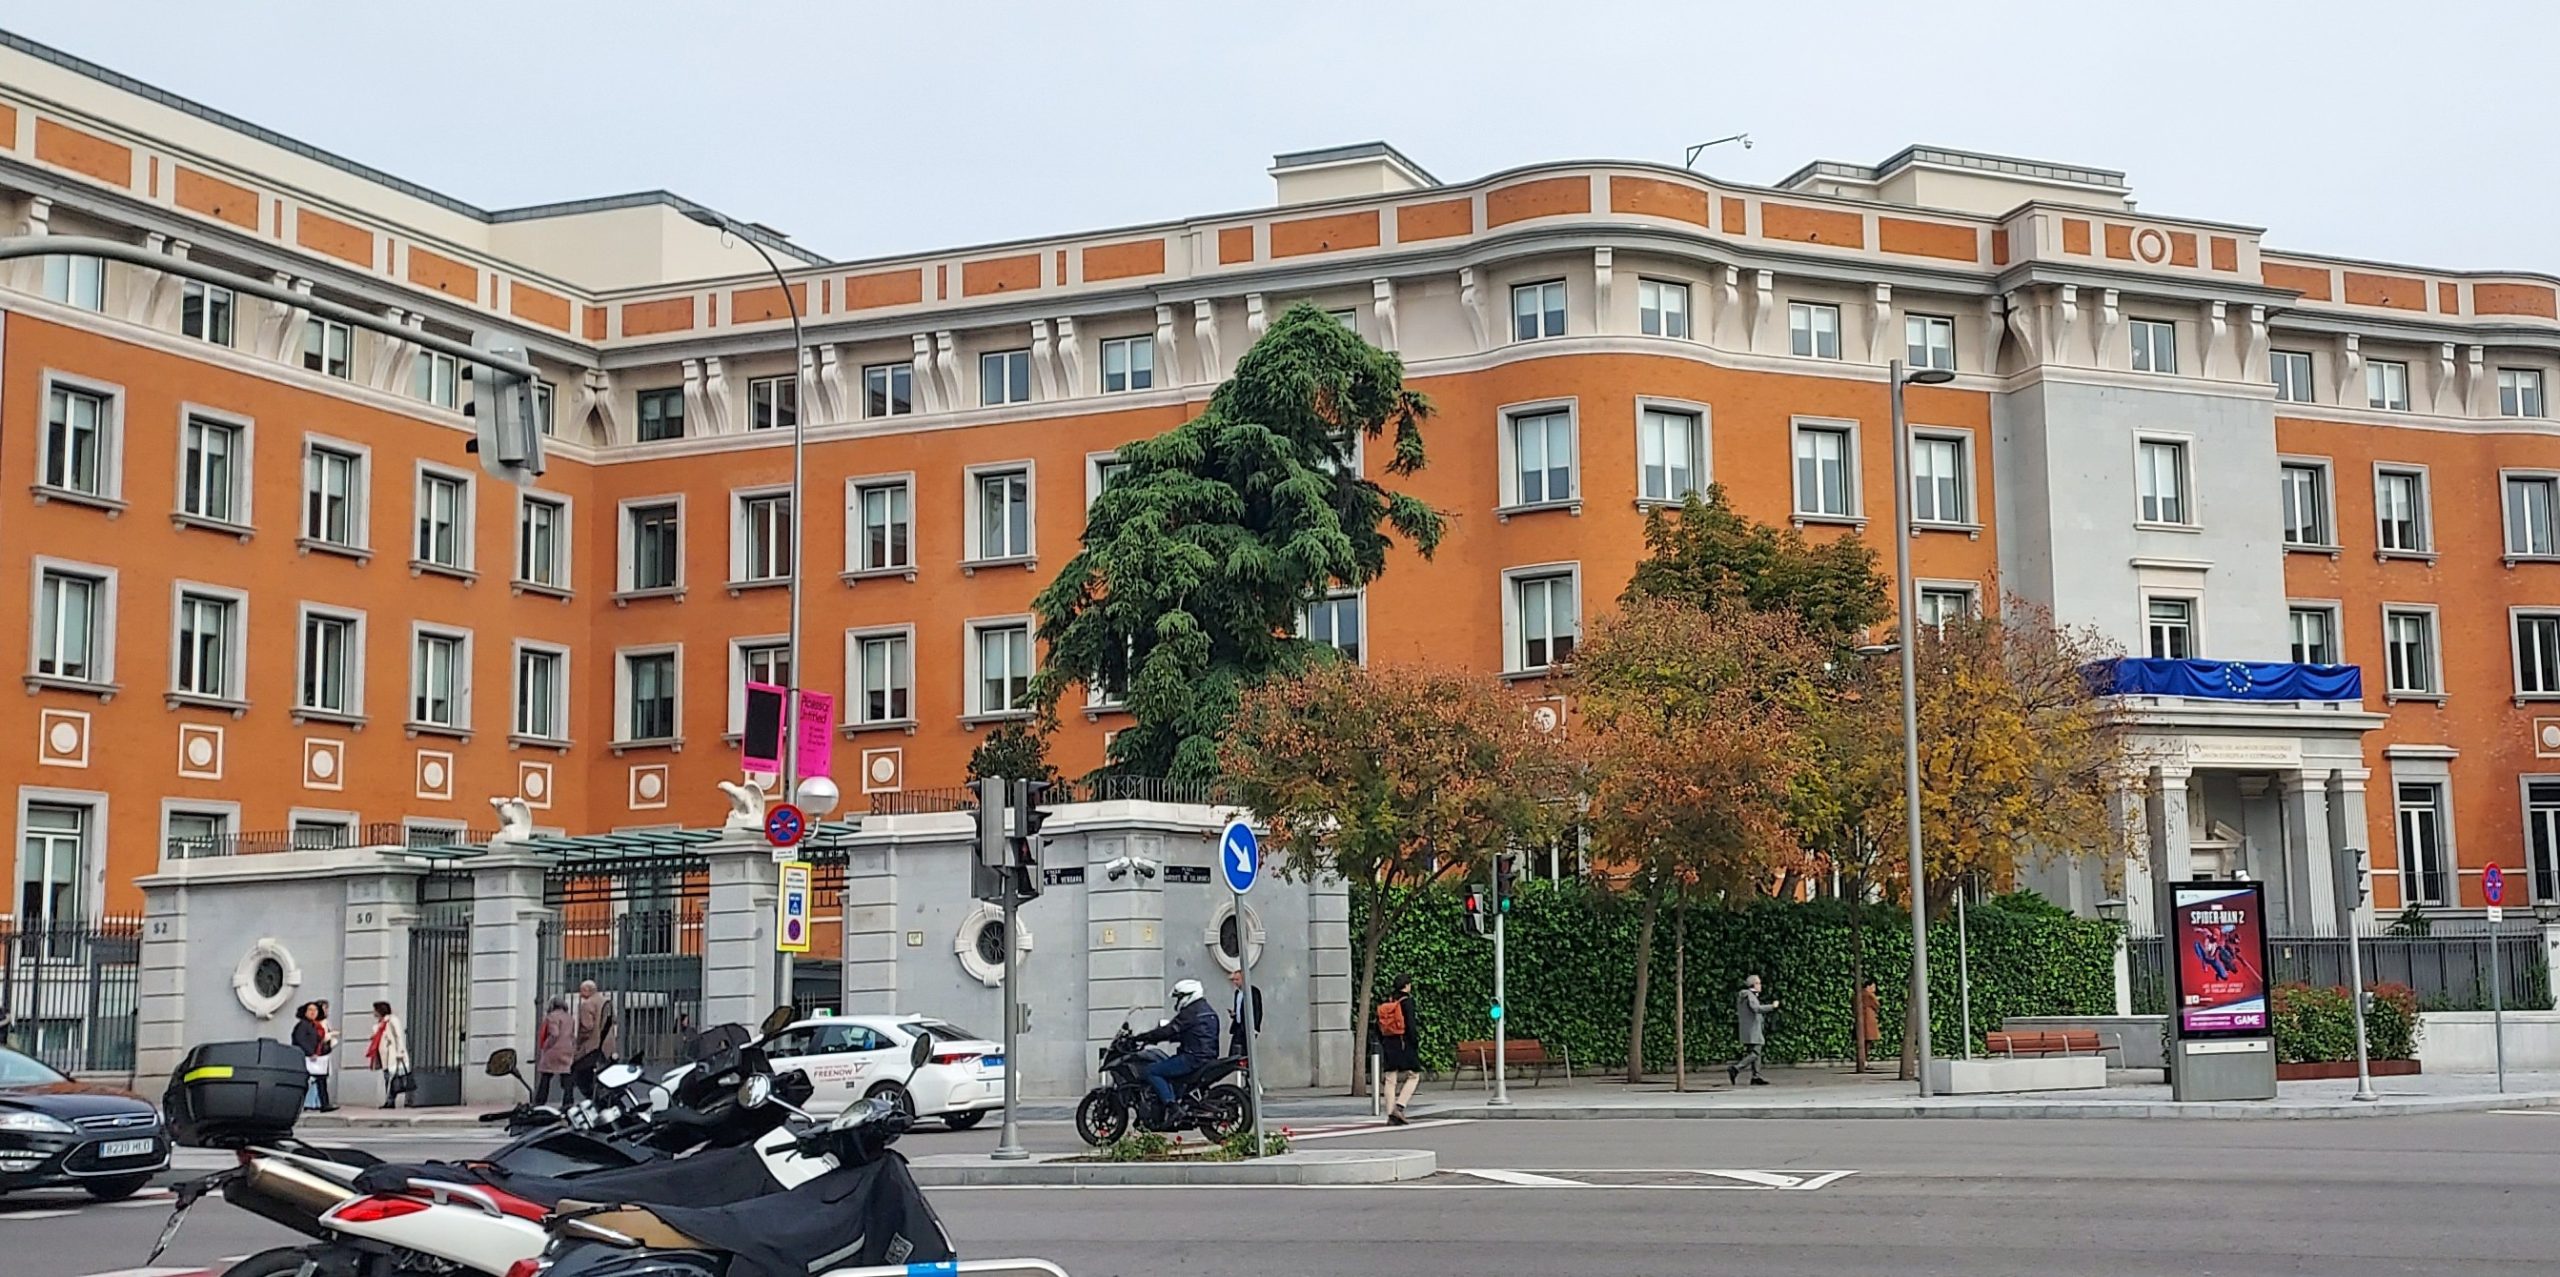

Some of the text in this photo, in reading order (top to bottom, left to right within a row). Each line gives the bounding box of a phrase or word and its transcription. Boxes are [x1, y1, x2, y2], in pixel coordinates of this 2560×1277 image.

[2191, 911, 2245, 924] SPIDER-MAN 2
[2234, 1015, 2260, 1025] GAME
[813, 1069, 853, 1079] FREENOW
